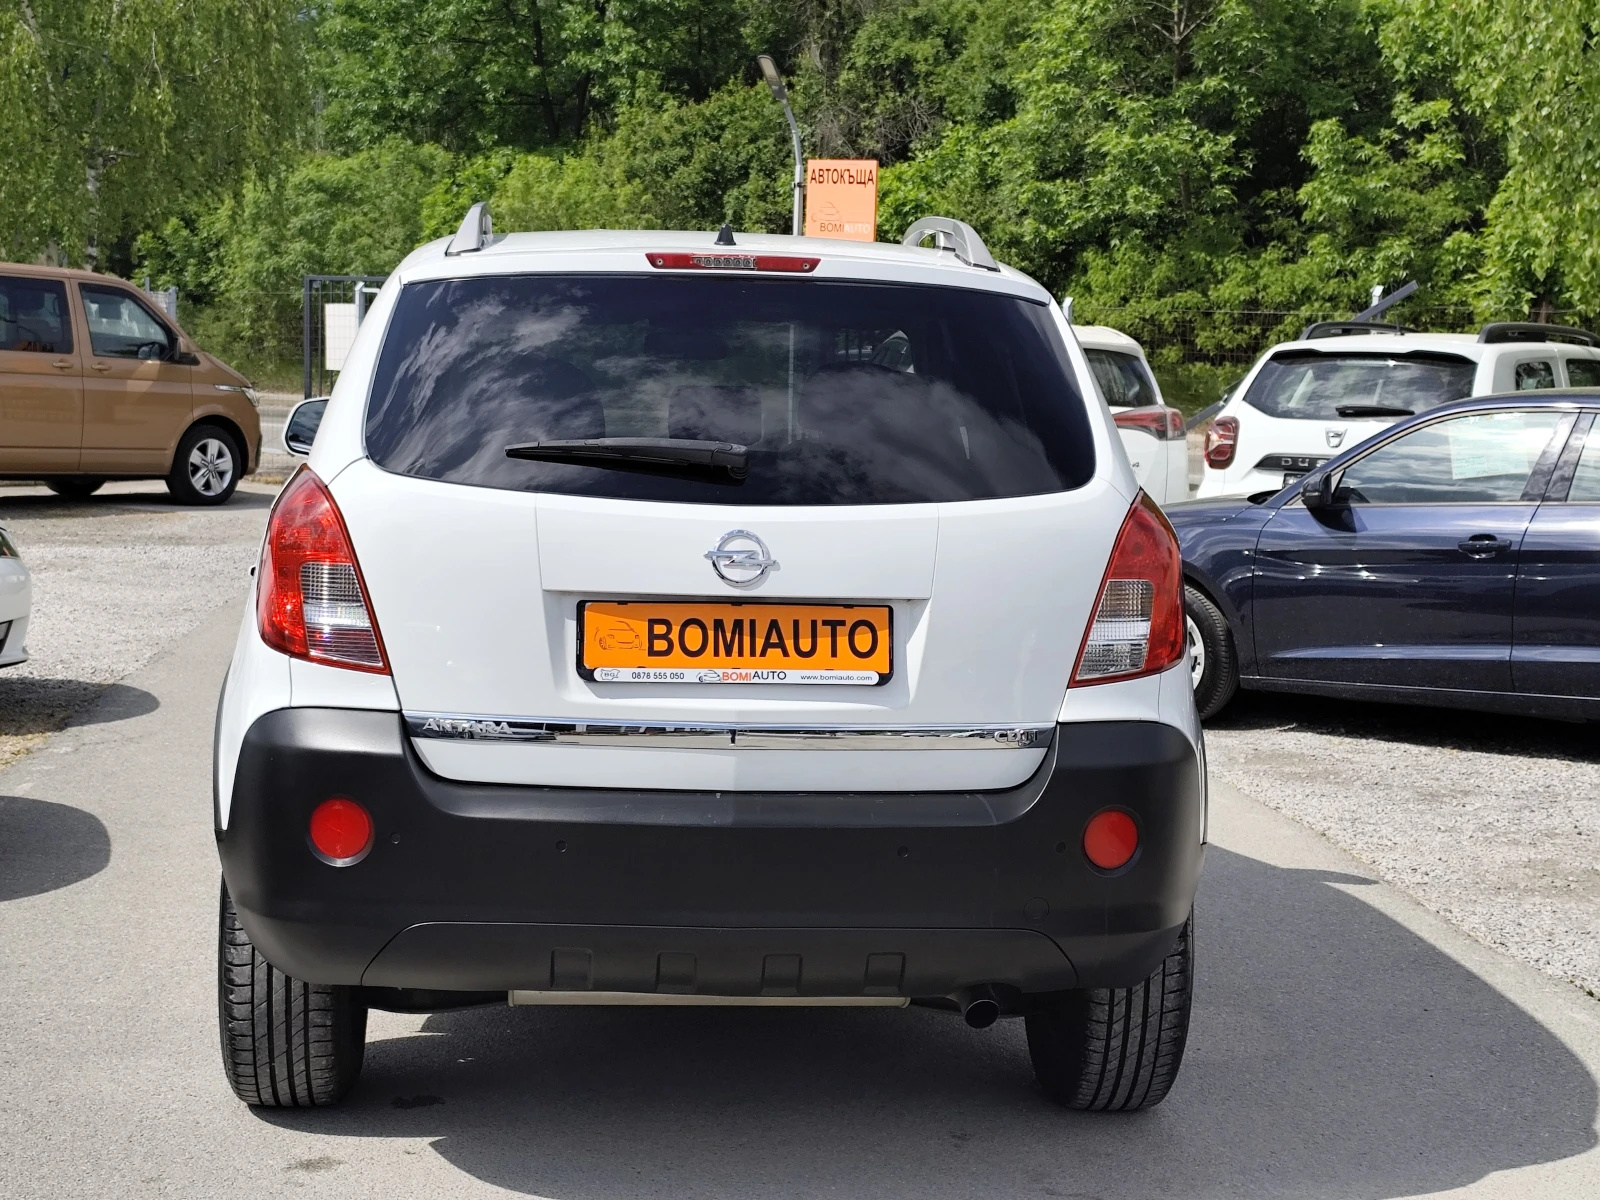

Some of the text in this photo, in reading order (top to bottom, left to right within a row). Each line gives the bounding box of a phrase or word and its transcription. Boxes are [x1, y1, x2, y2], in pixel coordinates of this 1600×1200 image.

[809, 168, 875, 188] АВТОКЪЩА
[646, 617, 879, 659] BOMIAUTO
[631, 671, 685, 680] 0878 555 050
[721, 671, 787, 682] BOMIAUTO
[800, 674, 873, 682] www.bomiauto.com
[422, 718, 513, 735] ANTARA
